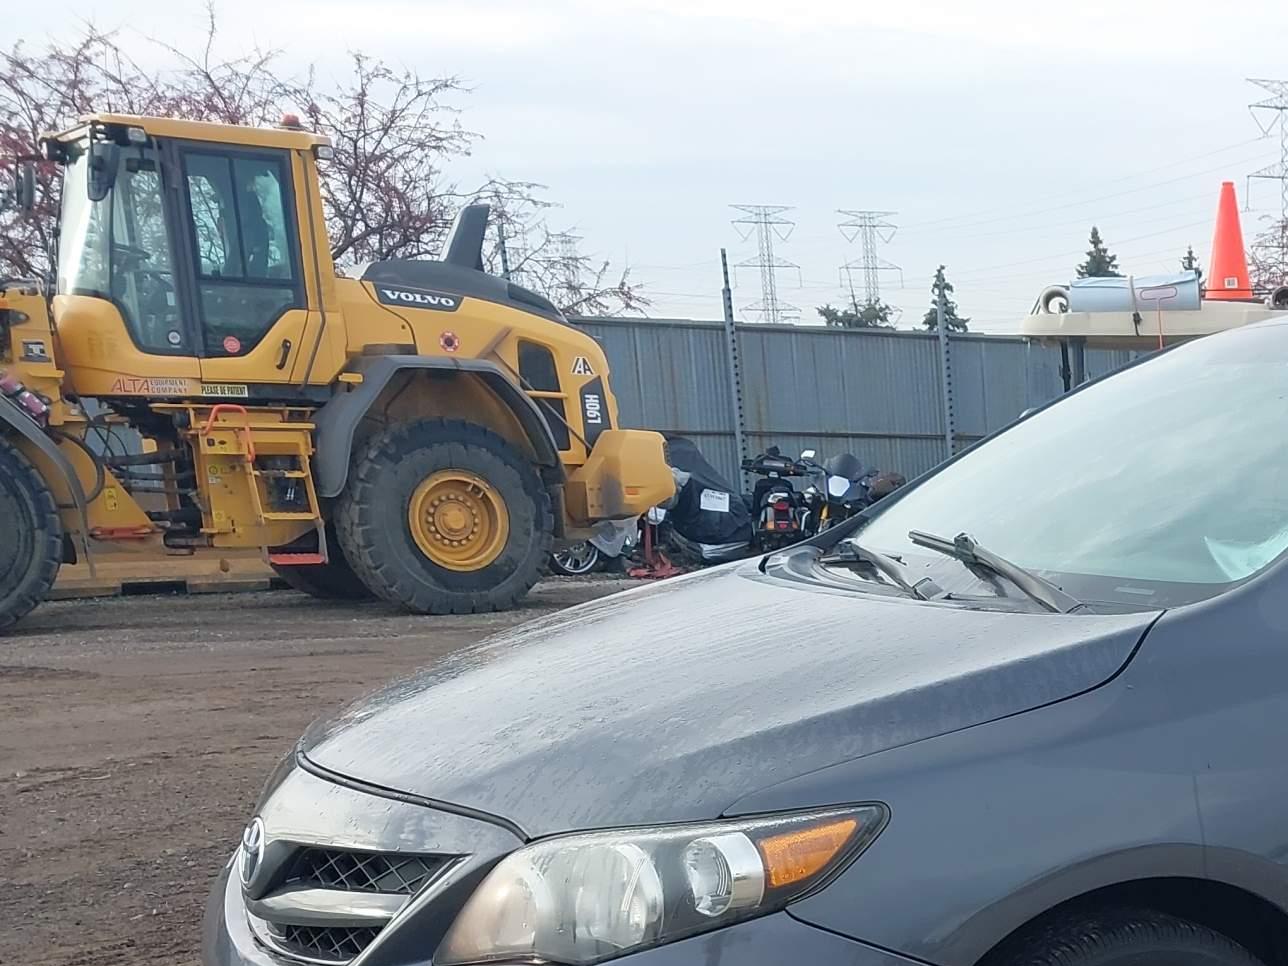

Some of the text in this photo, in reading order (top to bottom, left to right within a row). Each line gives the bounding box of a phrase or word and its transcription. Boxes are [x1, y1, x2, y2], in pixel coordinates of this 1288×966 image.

[381, 289, 455, 307] VOLVO
[110, 378, 150, 393] ALTA
[151, 386, 187, 394] COMPANY
[201, 385, 219, 395] PLEASE
[227, 385, 246, 395] PATIENT
[584, 394, 602, 424] L90H
